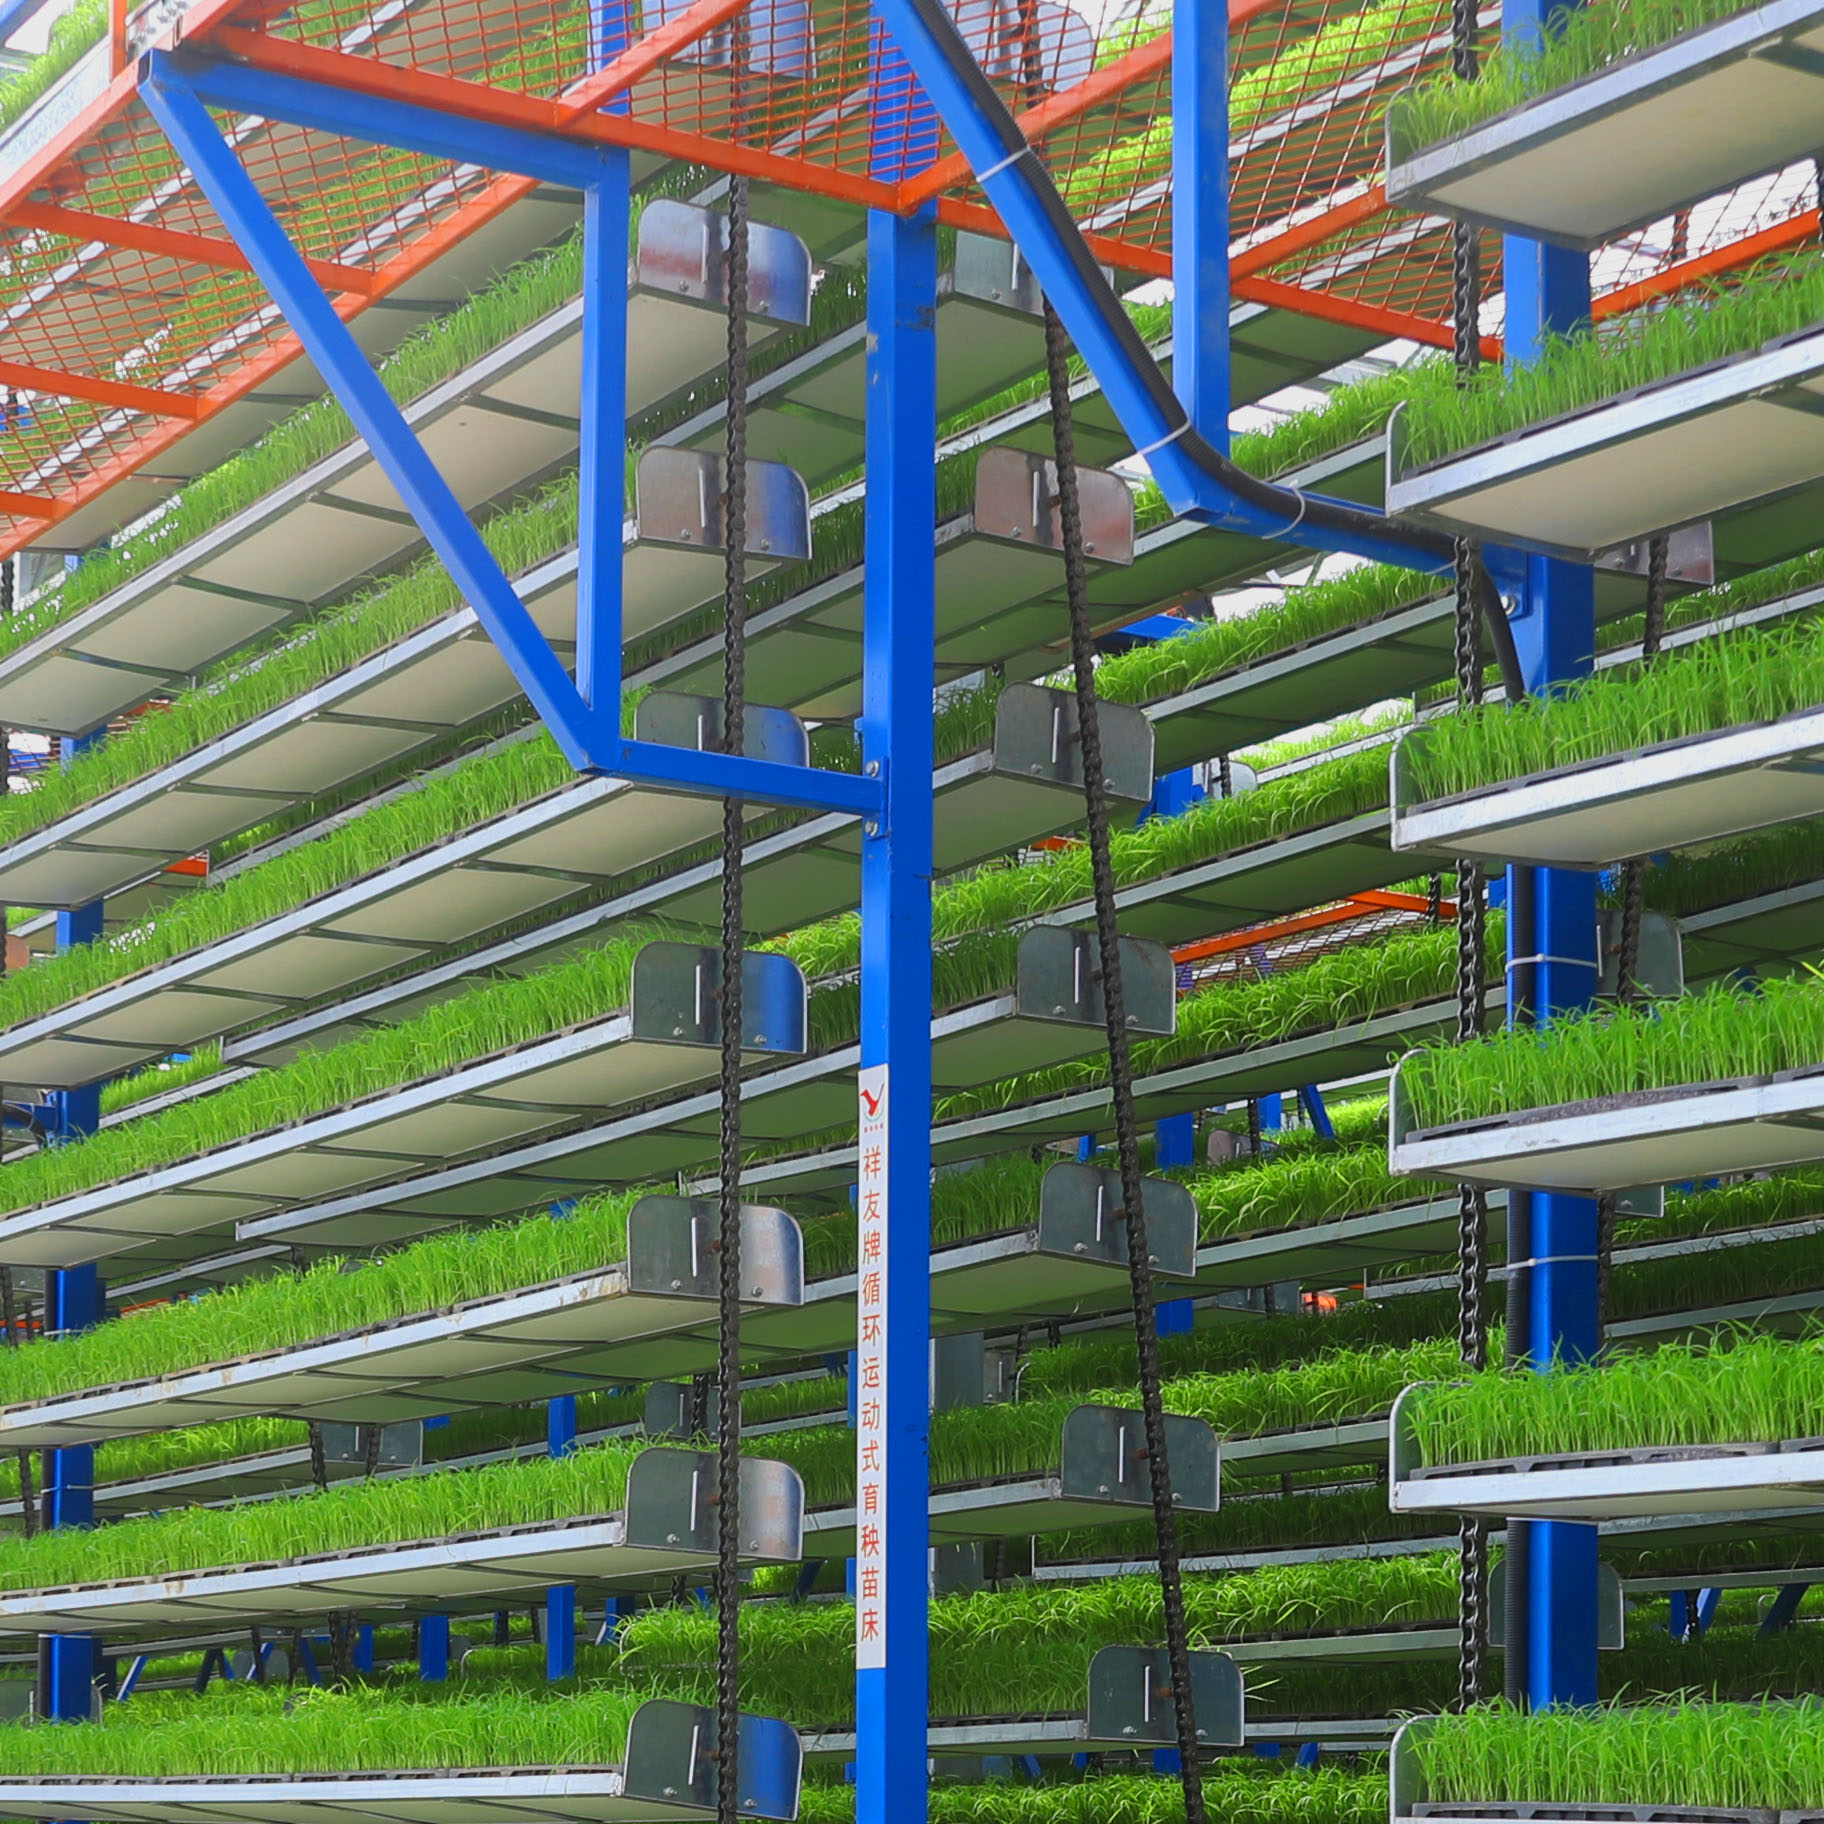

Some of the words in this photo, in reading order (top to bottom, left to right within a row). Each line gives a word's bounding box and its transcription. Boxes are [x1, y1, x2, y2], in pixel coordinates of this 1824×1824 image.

[861, 1146, 882, 1642] 祥友牌循环运动式育秧苗床
